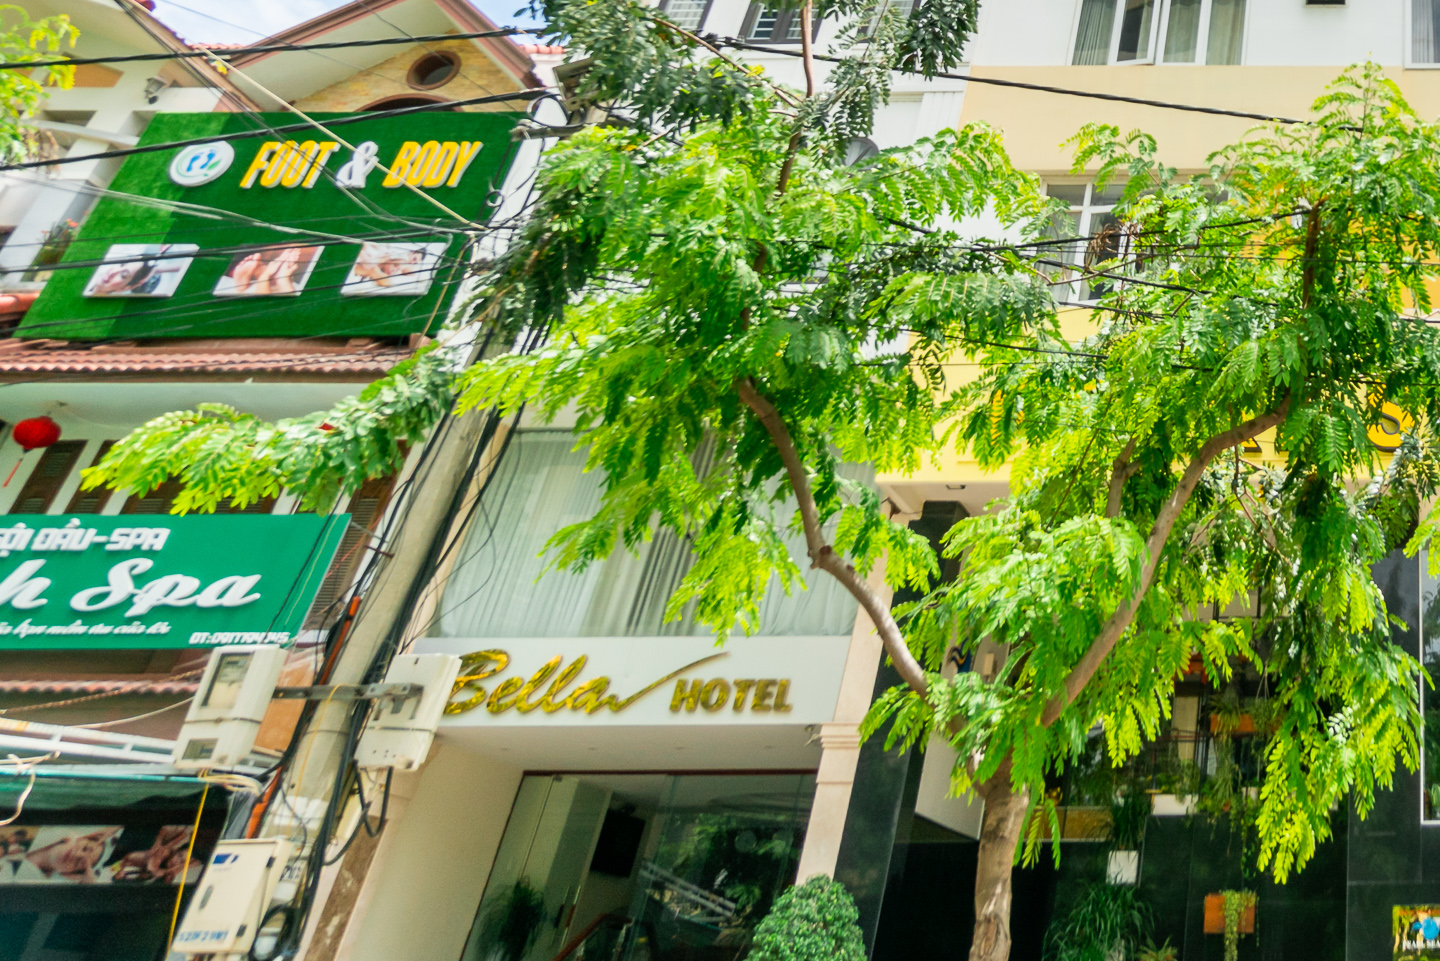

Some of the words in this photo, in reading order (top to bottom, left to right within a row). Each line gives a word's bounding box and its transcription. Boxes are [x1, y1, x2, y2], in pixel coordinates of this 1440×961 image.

[239, 140, 342, 188] FOOT
[335, 141, 379, 189] &
[382, 140, 484, 188] BODY
[69, 558, 262, 617] Spa
[443, 648, 730, 715] Bella
[669, 677, 793, 714] HOTEL
